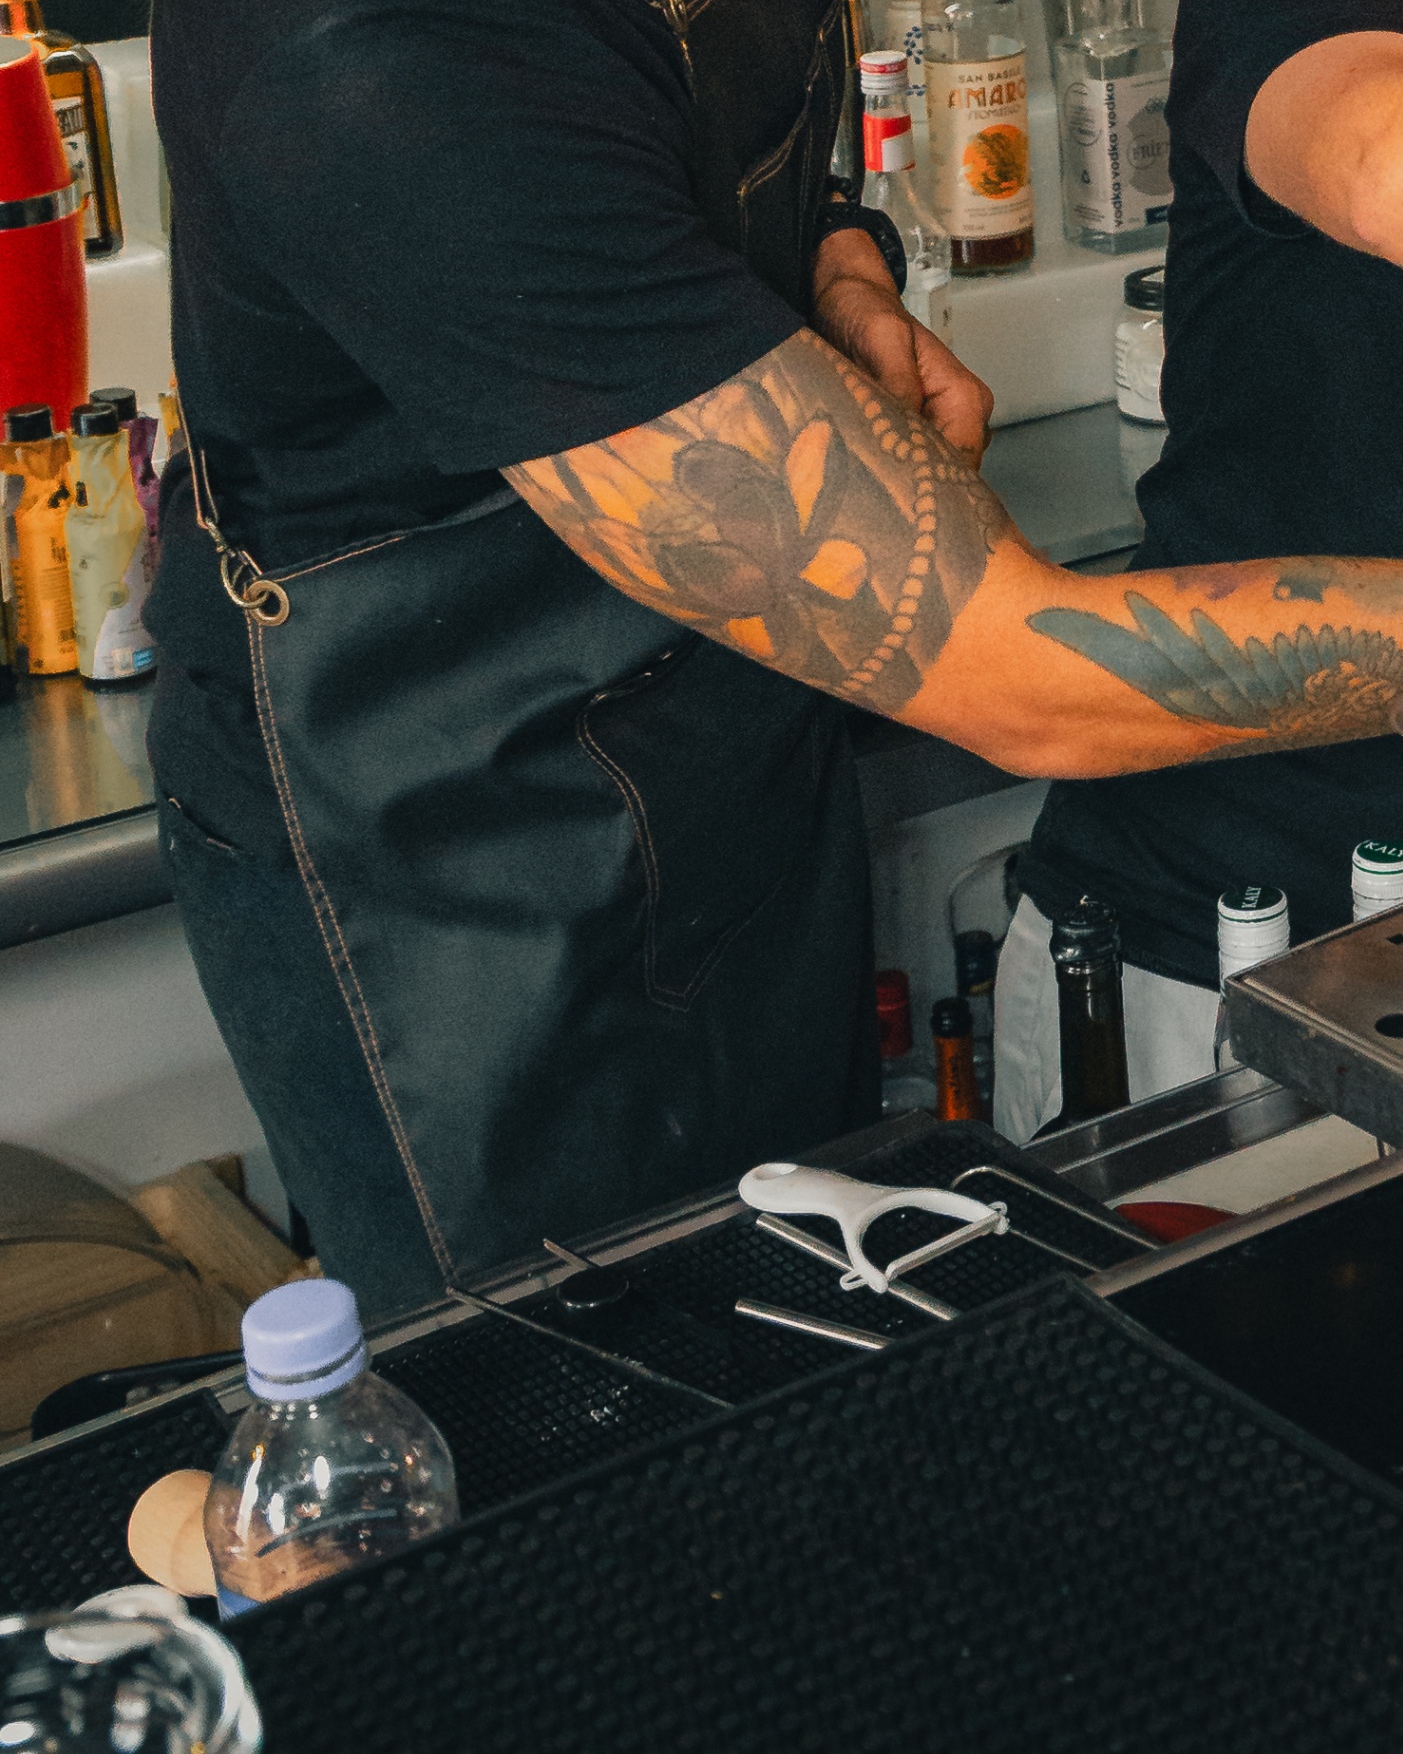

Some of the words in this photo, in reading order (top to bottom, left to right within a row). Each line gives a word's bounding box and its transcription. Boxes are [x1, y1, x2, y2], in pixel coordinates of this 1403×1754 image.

[948, 77, 1027, 108] AMARO
[958, 74, 983, 84] SAN
[1104, 82, 1116, 129] vodka
[1108, 133, 1120, 179] vodka
[1111, 182, 1123, 227] vodka
[1241, 886, 1261, 908] KALY
